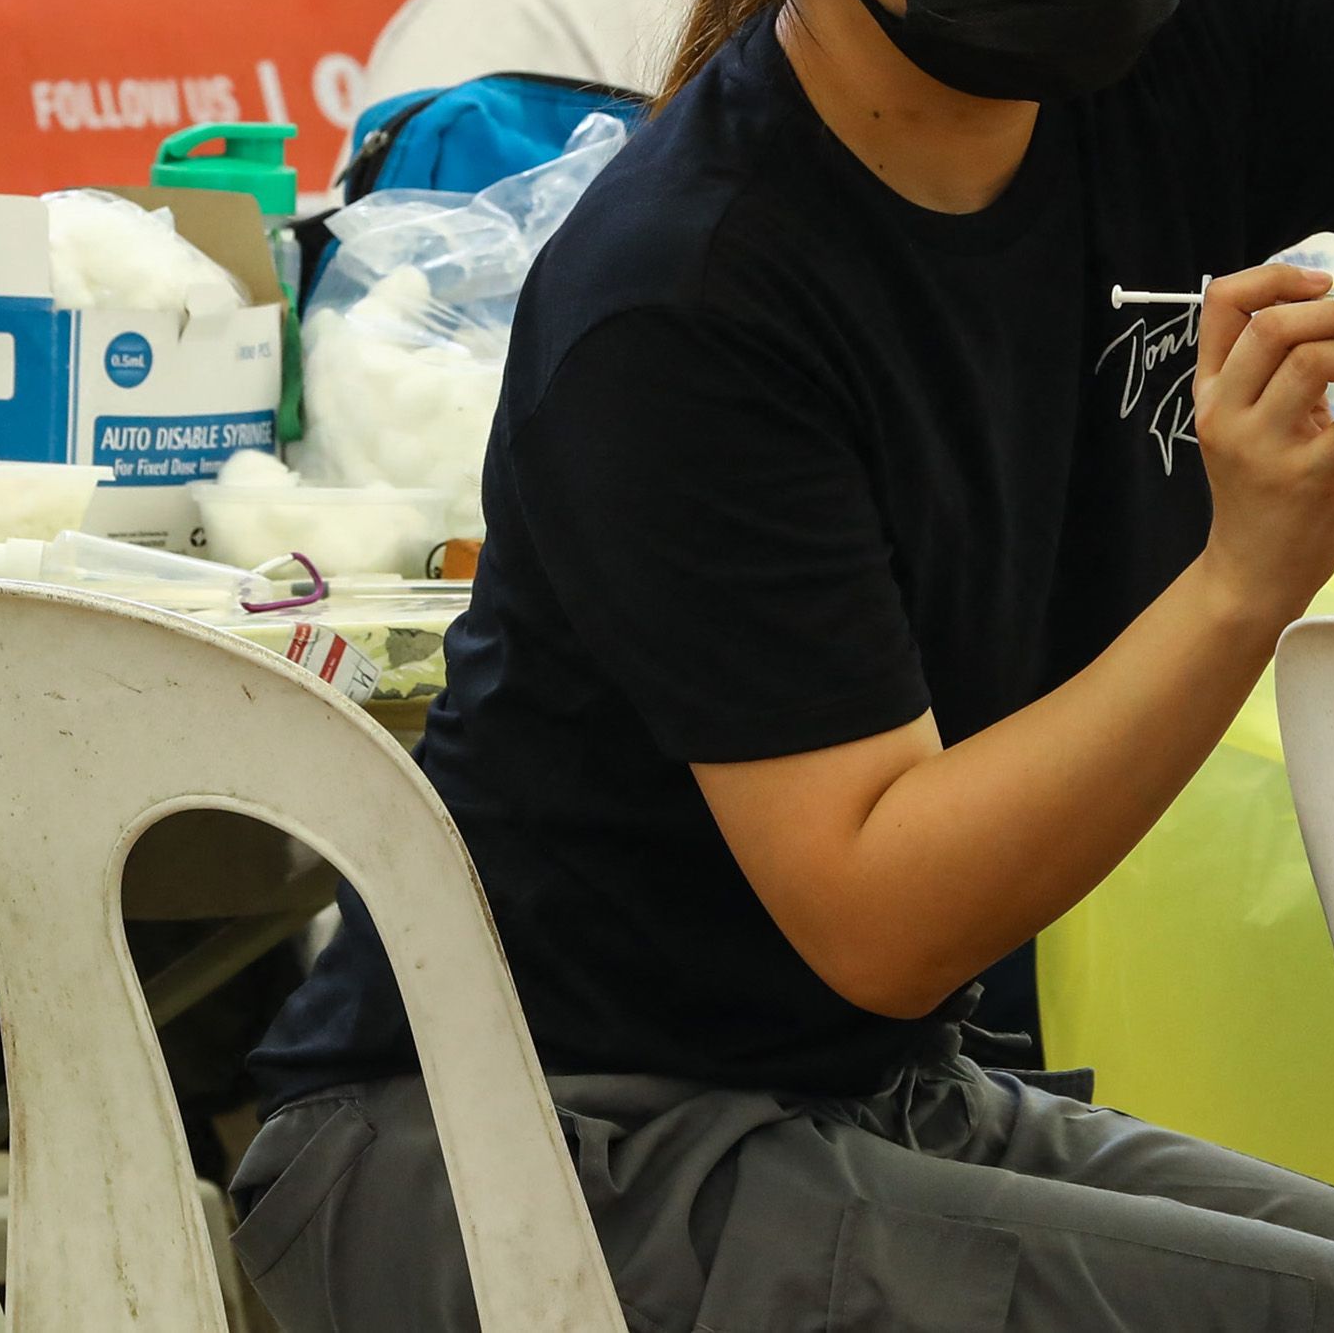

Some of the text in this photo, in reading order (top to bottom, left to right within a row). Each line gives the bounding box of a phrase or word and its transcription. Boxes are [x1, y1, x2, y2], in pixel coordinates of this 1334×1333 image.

[181, 74, 242, 125] US
[100, 420, 273, 452] AUTO DISABLE SYRINGE
